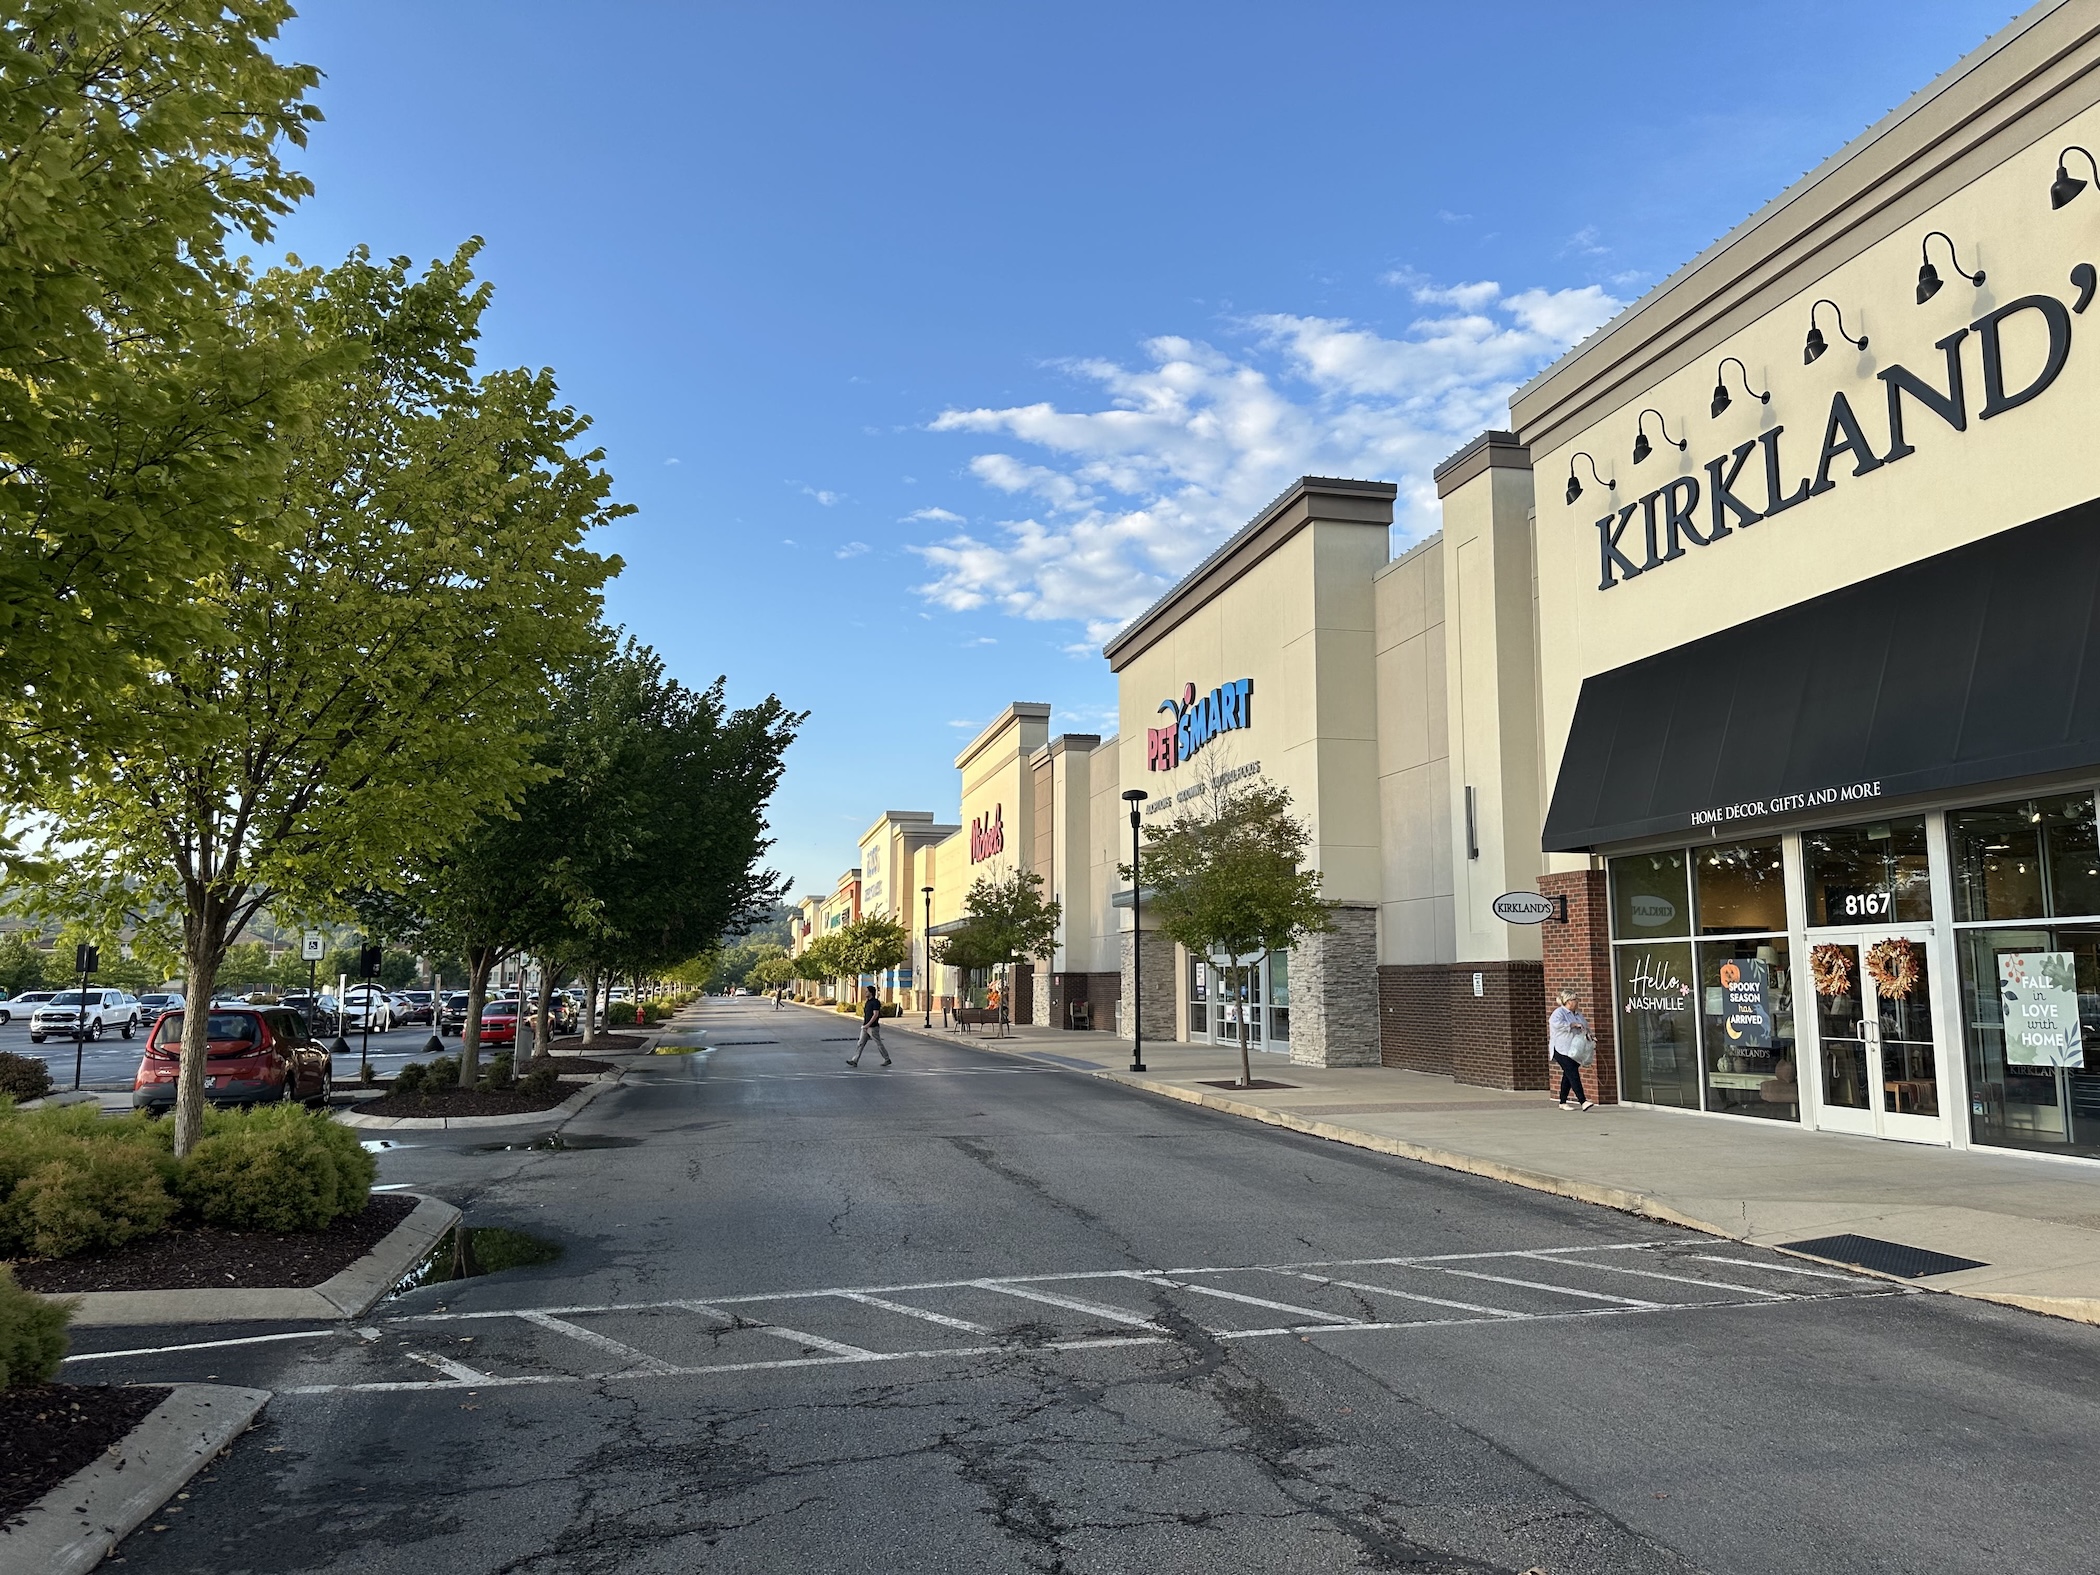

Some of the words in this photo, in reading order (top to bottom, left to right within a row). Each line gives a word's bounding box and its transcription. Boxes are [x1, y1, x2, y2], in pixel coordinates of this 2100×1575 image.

[1690, 807, 1723, 826] HOME
[1725, 801, 1768, 820] DÉCOR,
[1770, 794, 1805, 813] GIFTS
[1806, 788, 1838, 807] AND
[1840, 781, 1882, 801] MORE
[1497, 903, 1552, 914] KIRKLAND'S
[1845, 892, 1891, 916] 8167
[1728, 982, 1761, 992] SPOOKY
[2021, 976, 2054, 989] FALL
[1729, 993, 1761, 1003] SEASON
[2032, 990, 2047, 1001] in
[1628, 996, 1685, 1011] NASHVILLE
[1738, 1003, 1753, 1013] has
[2021, 1004, 2059, 1018] LOVE
[1730, 1014, 1763, 1025] ARRIVED
[2027, 1018, 2058, 1030] with
[2021, 1032, 2065, 1047] HOME
